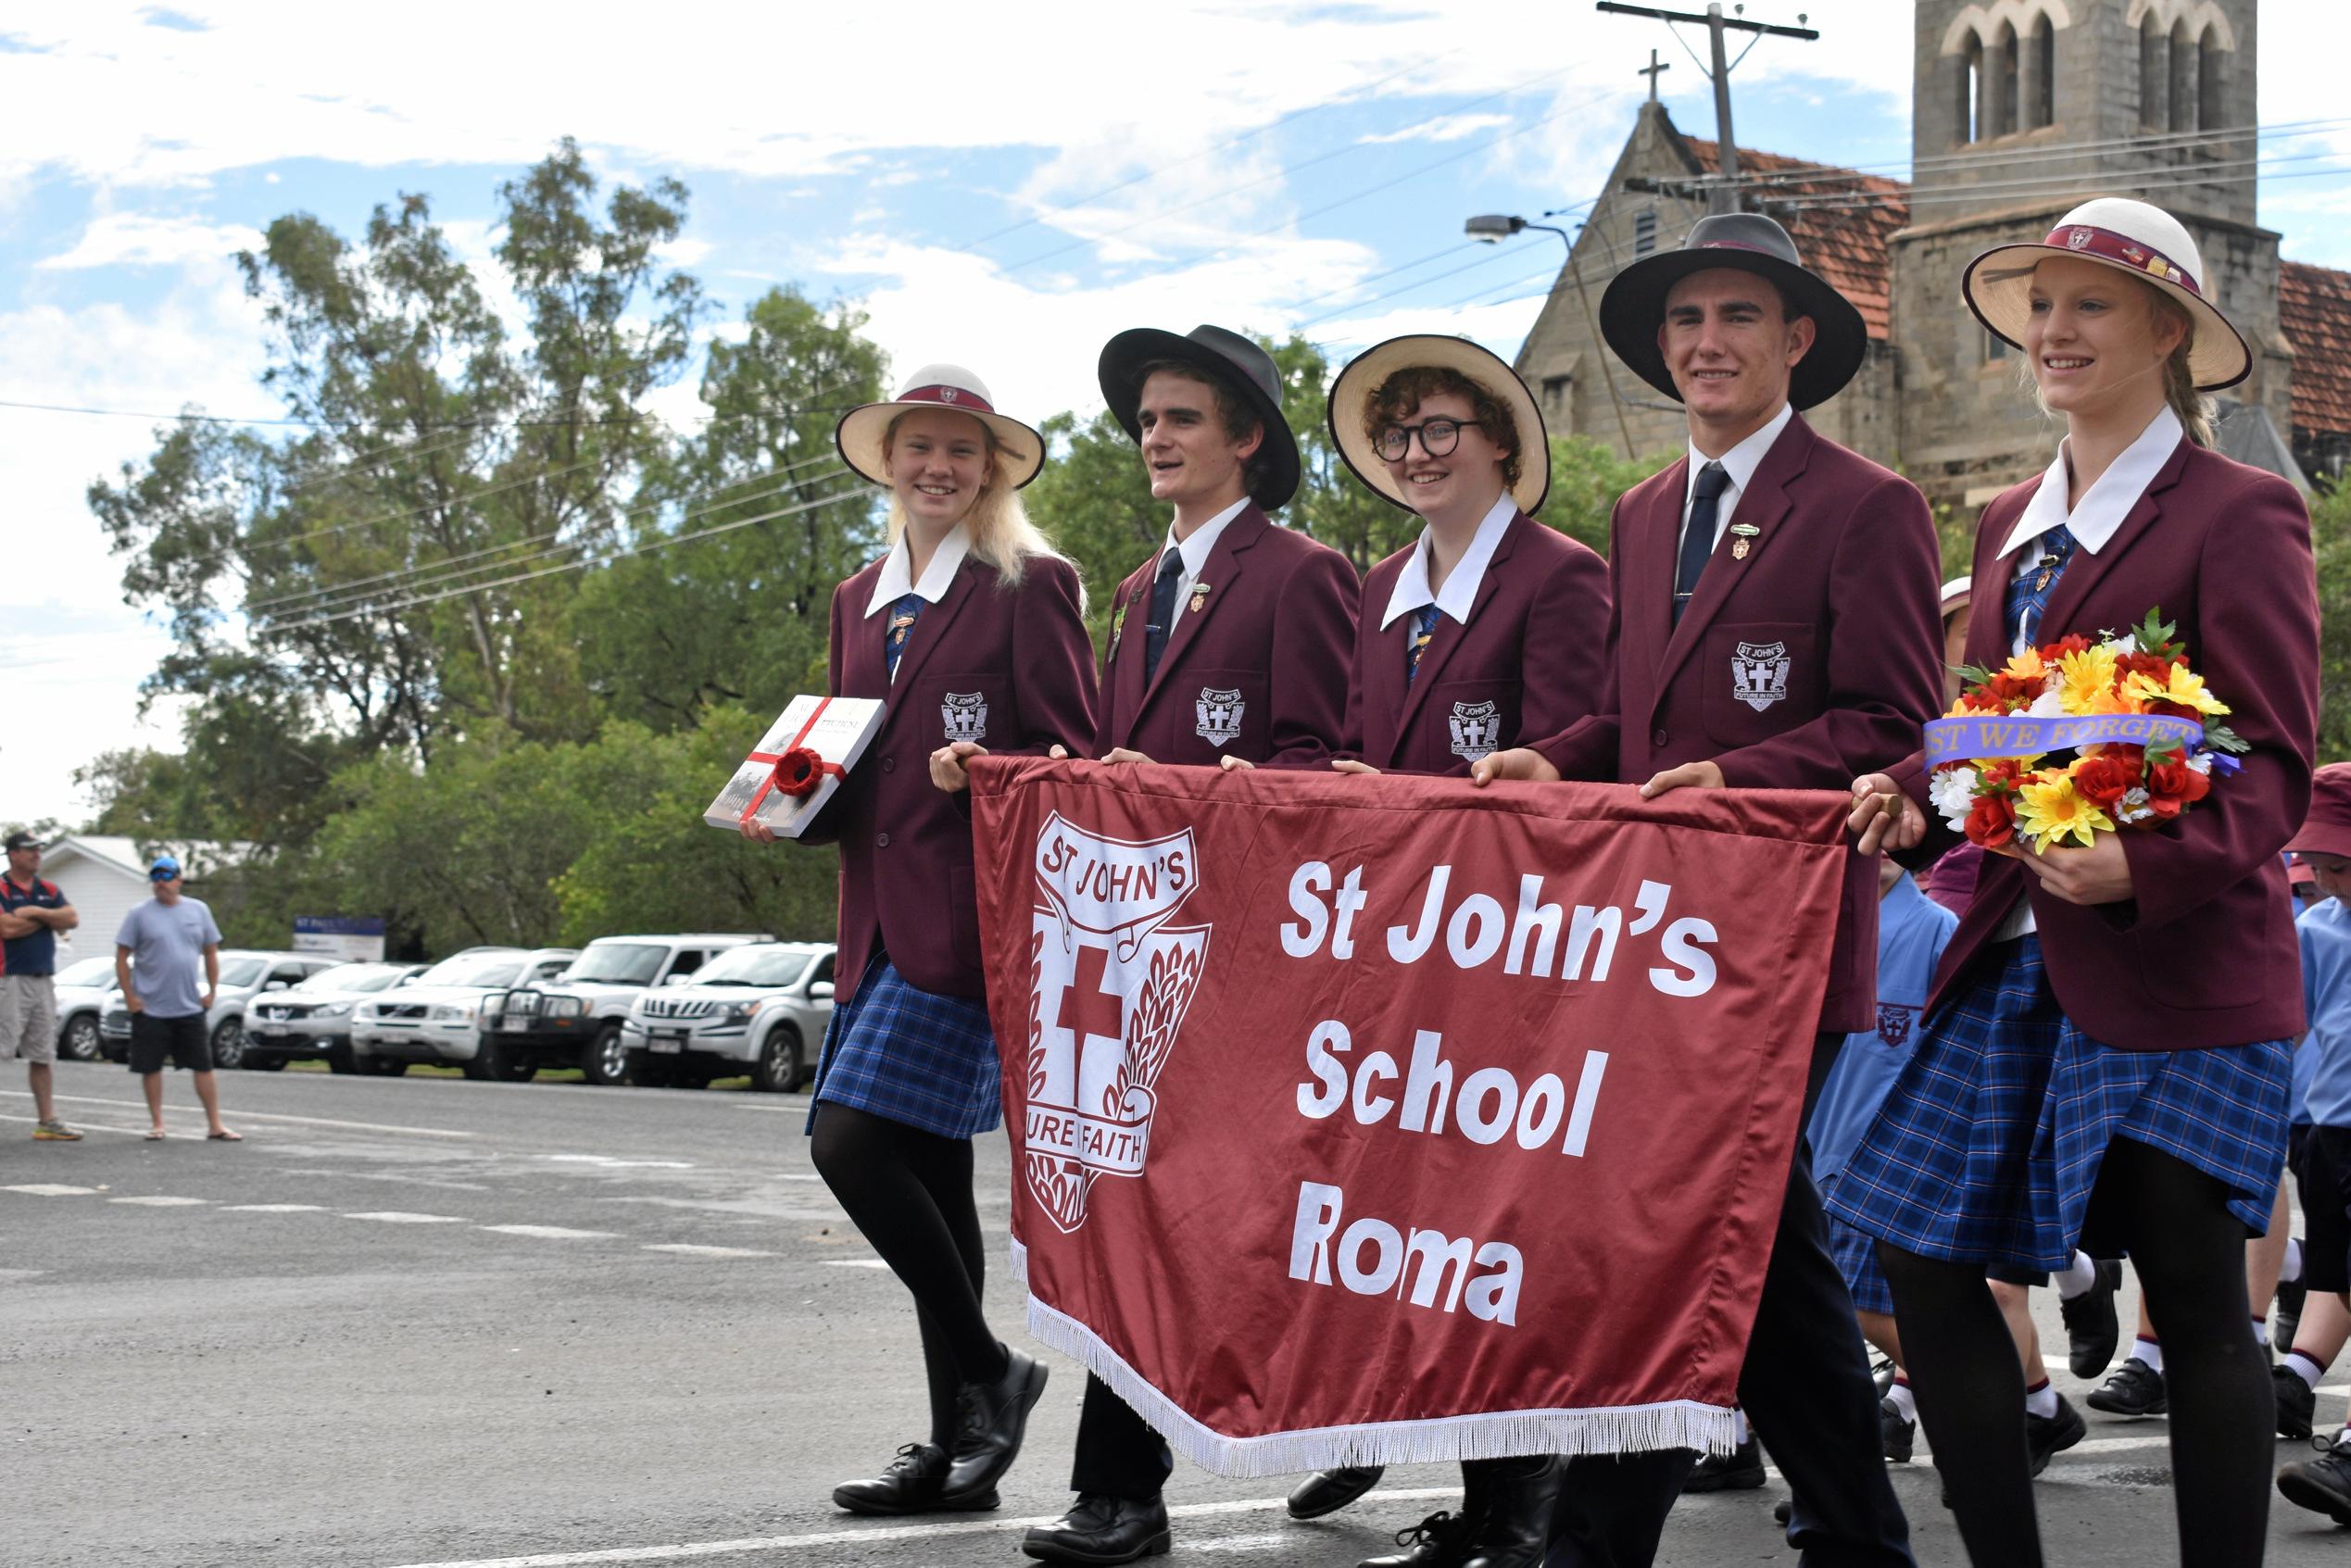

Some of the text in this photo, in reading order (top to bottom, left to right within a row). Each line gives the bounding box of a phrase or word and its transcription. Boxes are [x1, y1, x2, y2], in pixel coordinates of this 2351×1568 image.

[1740, 645, 1782, 658] ST JOHN'S
[948, 695, 981, 705] ST JOHN'S
[1204, 691, 1238, 702] ST JOHN'S
[1455, 703, 1492, 716] ST JOHN'S
[1924, 718, 2197, 756] ST WE FORGET
[1042, 834, 1187, 904] ST JOHN'S
[1280, 860, 1718, 997] St John's
[1297, 1019, 1609, 1158] School
[1082, 1125, 1141, 1163] FAITH
[1289, 1180, 1524, 1327] Roma
